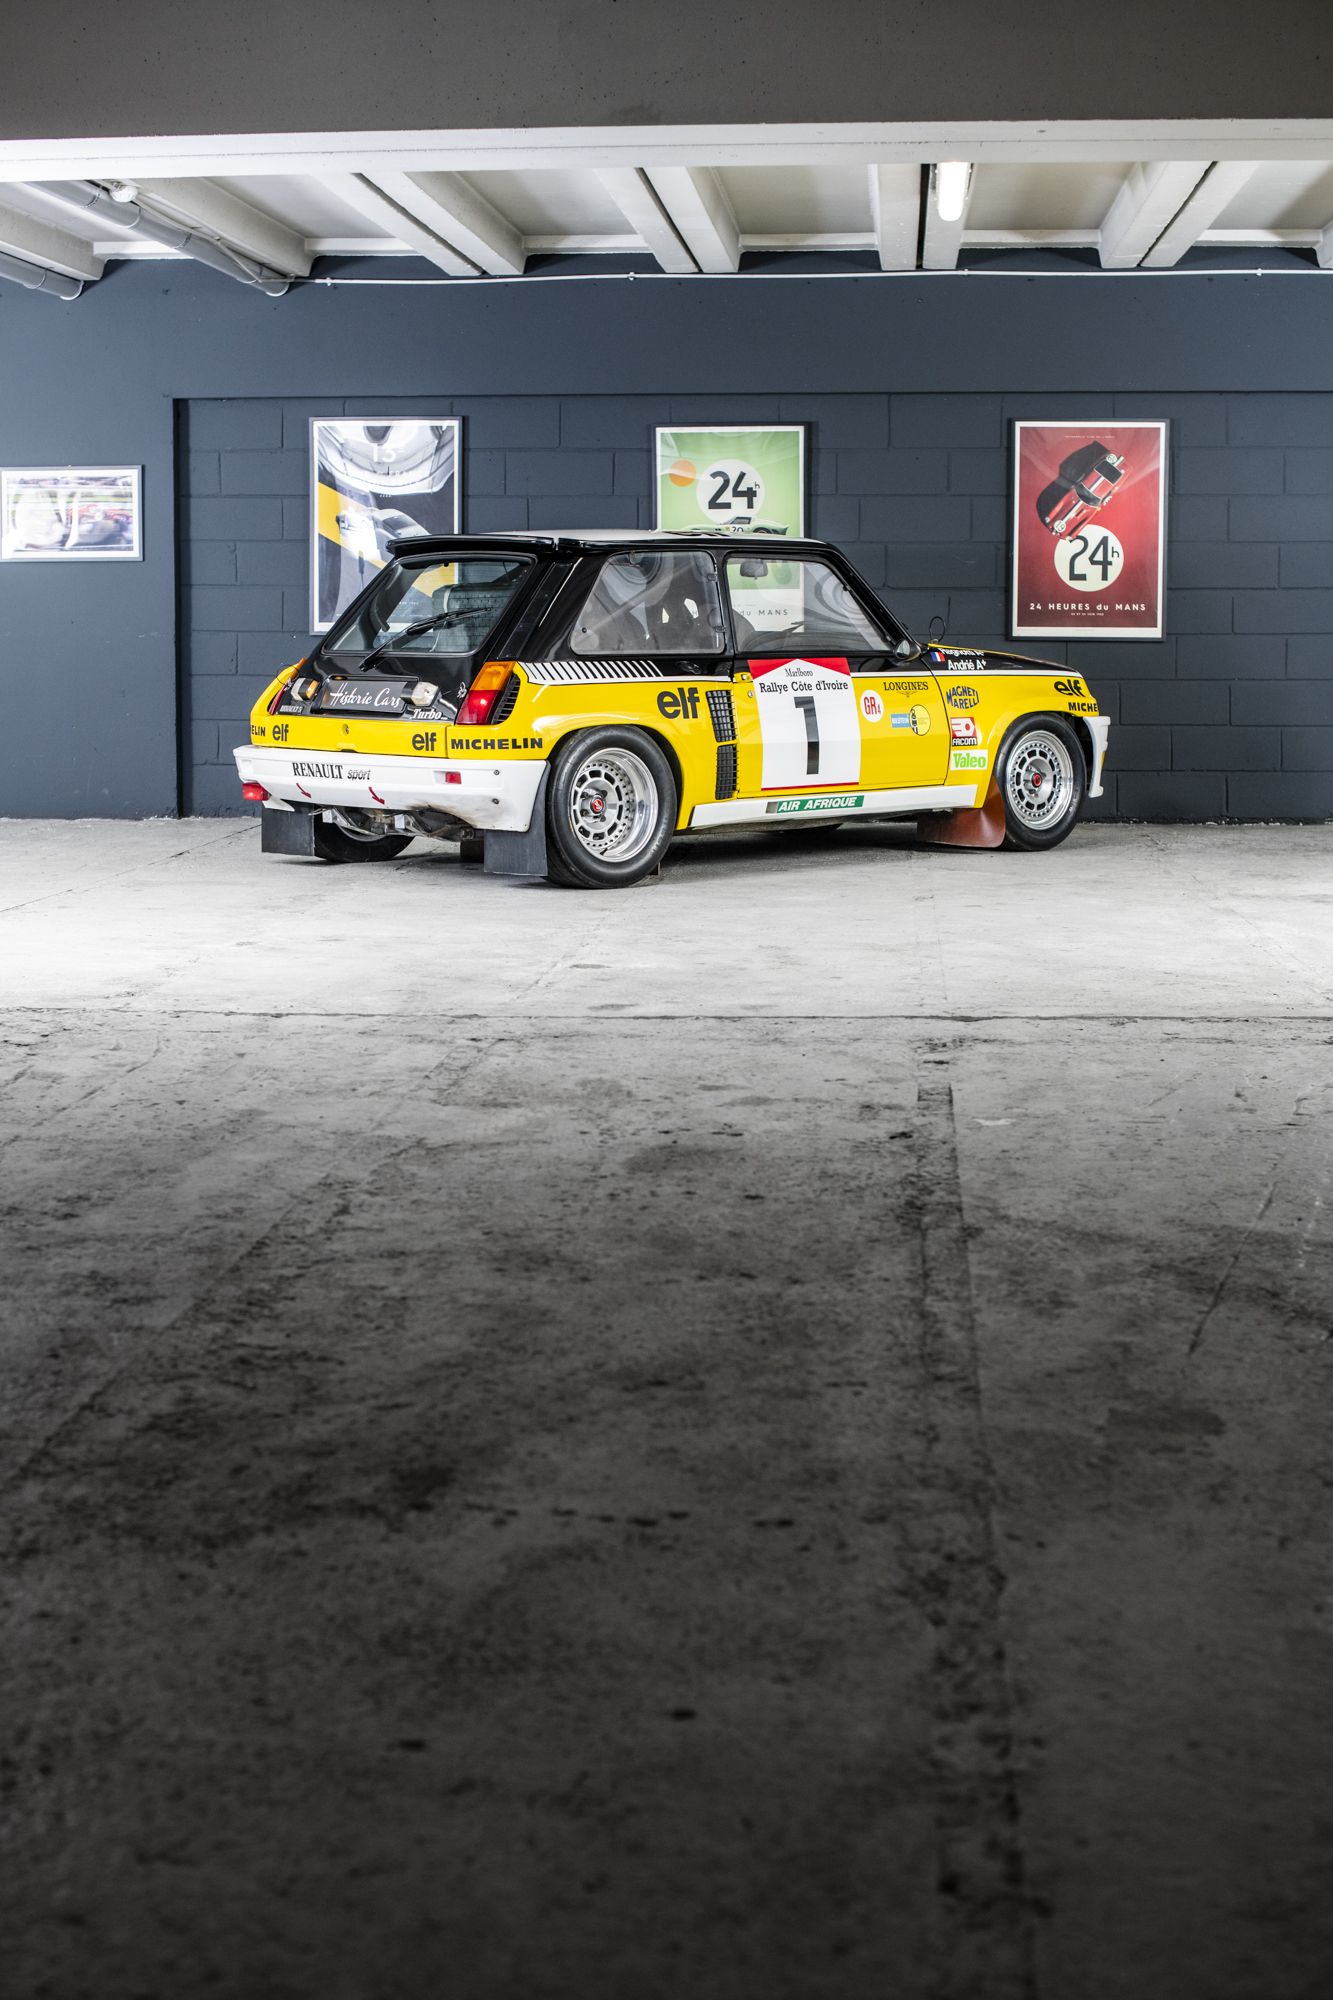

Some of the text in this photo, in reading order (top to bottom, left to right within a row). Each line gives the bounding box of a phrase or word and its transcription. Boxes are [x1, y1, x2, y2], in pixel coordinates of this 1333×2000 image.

[1096, 603, 1109, 611] du
[1115, 603, 1146, 611] MANS
[785, 667, 814, 677] Marlboro
[947, 659, 975, 670] Andrié
[759, 679, 849, 694] Rallye Côte d'Ivoire
[883, 681, 929, 691] LONGINES
[1053, 679, 1086, 698] elf
[330, 682, 401, 708] Historic Cars
[657, 687, 700, 719] elf
[411, 708, 443, 720] Turbo
[1068, 701, 1099, 713] MICHE
[272, 723, 289, 742] elf
[794, 695, 820, 775] 1
[412, 732, 437, 751] elf
[451, 738, 543, 750] MICHELIN
[953, 753, 986, 769] Valeo
[292, 762, 372, 781] RENAULT sport
[778, 796, 858, 812] AIR AFRIQUE
